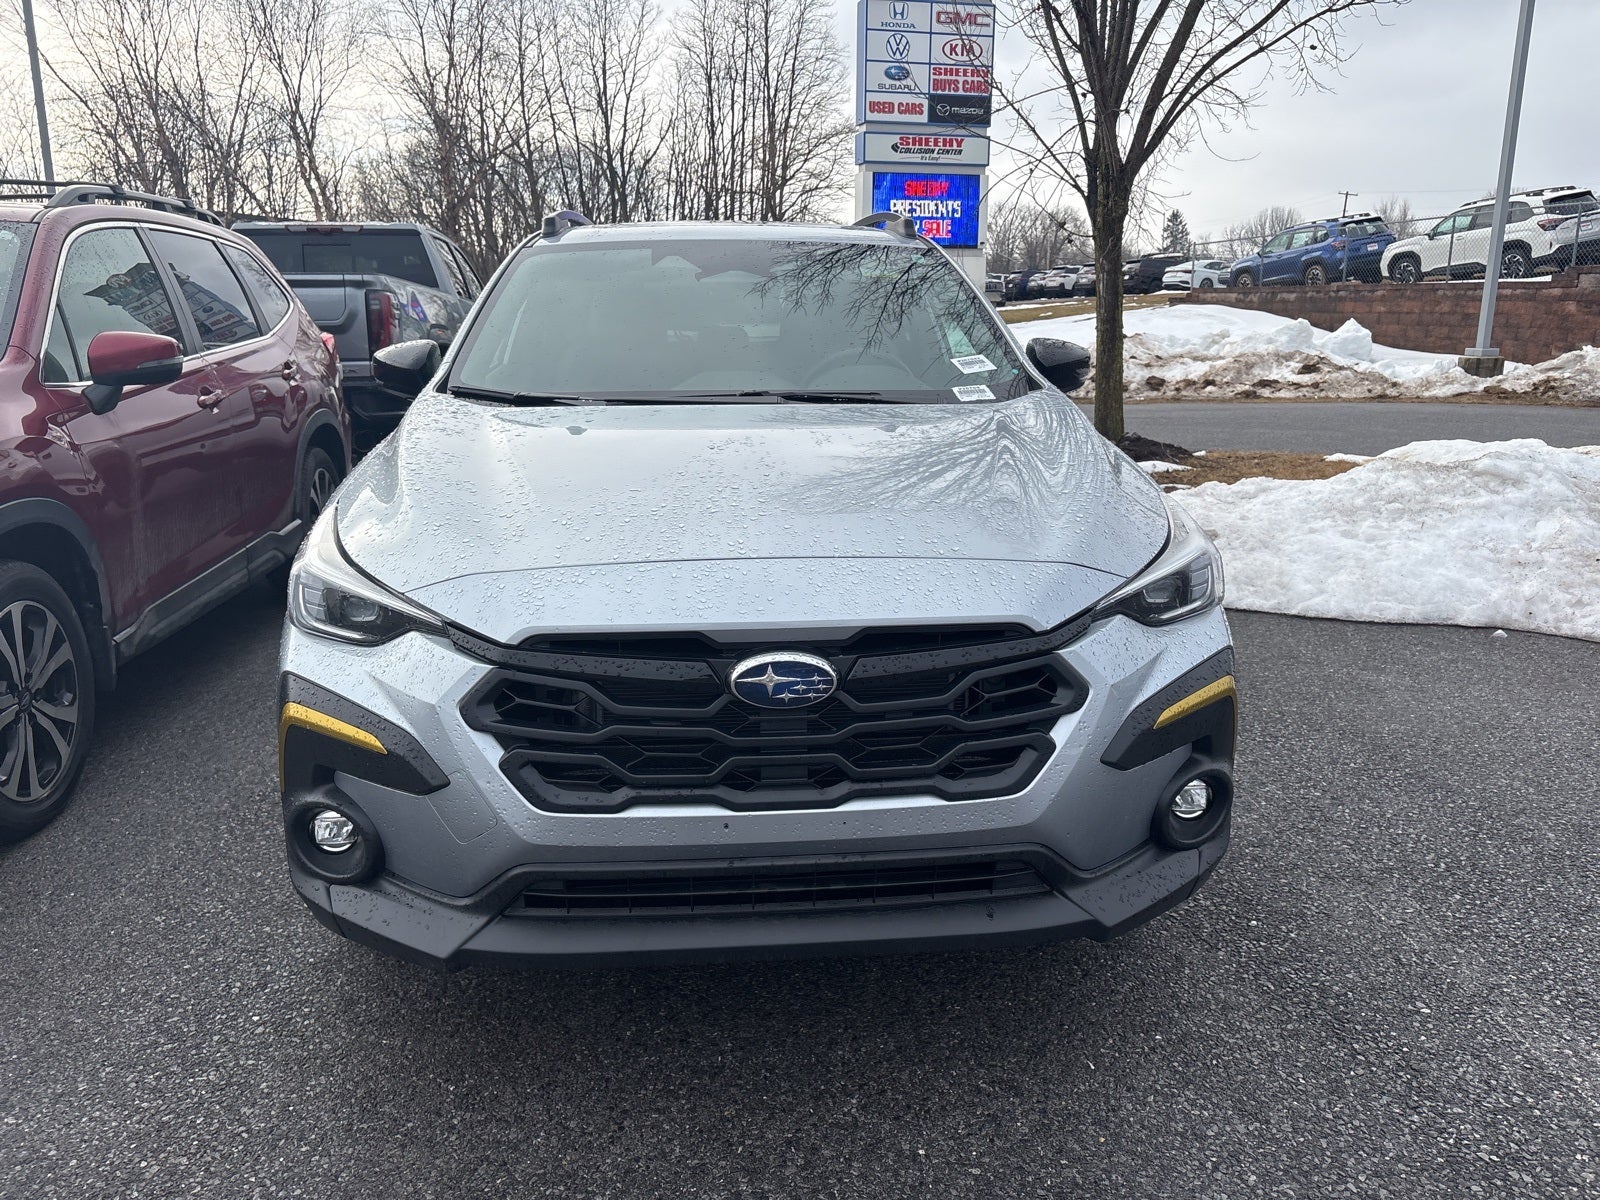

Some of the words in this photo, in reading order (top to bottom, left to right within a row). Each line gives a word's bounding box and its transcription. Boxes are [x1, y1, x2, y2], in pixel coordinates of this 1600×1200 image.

[880, 21, 917, 29] HONDA
[936, 11, 990, 27] GMC
[949, 43, 975, 57] KIA
[932, 66, 990, 79] SHEEHY
[877, 82, 916, 91] SUBARU
[932, 78, 960, 93] BUYS
[962, 79, 990, 94] CARS
[868, 101, 895, 115] USED
[897, 101, 924, 116] CARS
[898, 136, 965, 148] SHEEHY
[899, 147, 935, 155] COLLISION
[936, 148, 963, 156] CENTER
[890, 199, 961, 217] PRESIDENTS
